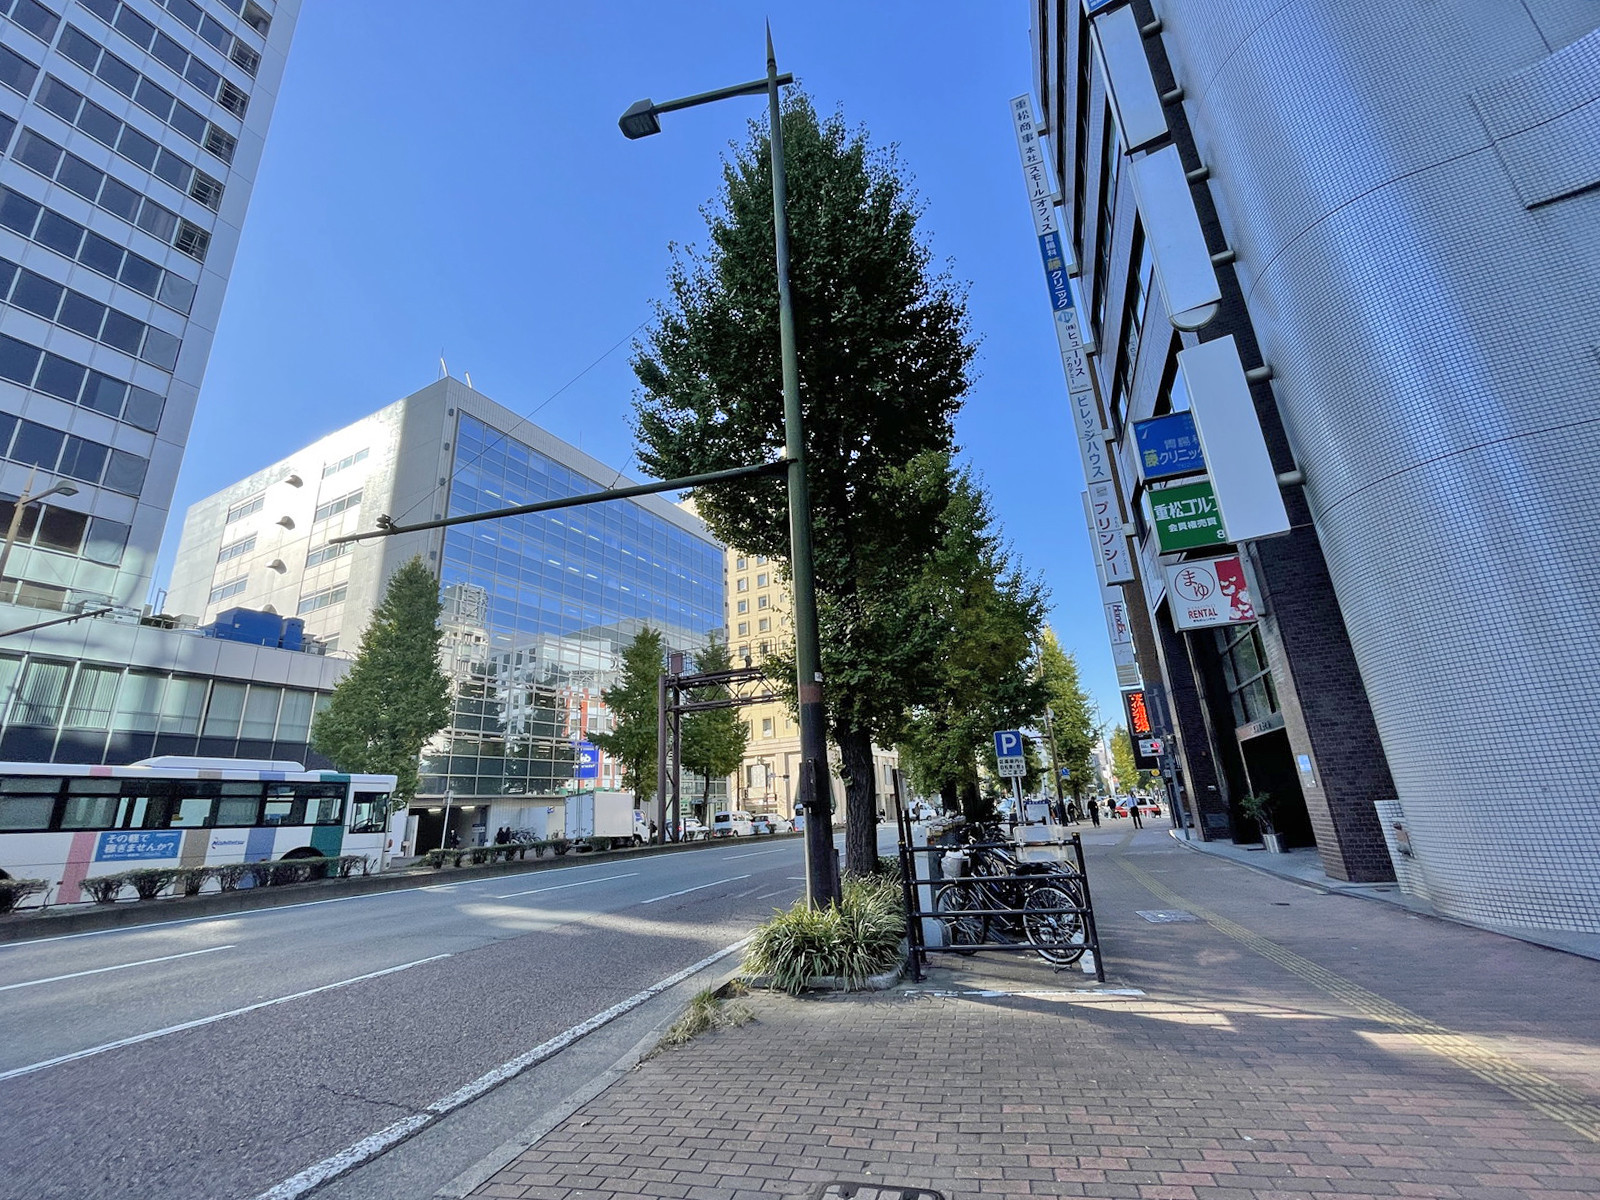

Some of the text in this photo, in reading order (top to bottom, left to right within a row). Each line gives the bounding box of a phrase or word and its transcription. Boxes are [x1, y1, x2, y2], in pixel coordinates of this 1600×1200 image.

[1030, 166, 1052, 232] スモールオフィス
[1078, 395, 1104, 478] ビレッジハウス
[1095, 501, 1118, 576] プリンシー
[1168, 517, 1217, 532] 会員権売買
[1181, 570, 1209, 598] まゆ
[1187, 608, 1218, 619] RENTAL
[1001, 733, 1017, 755] P
